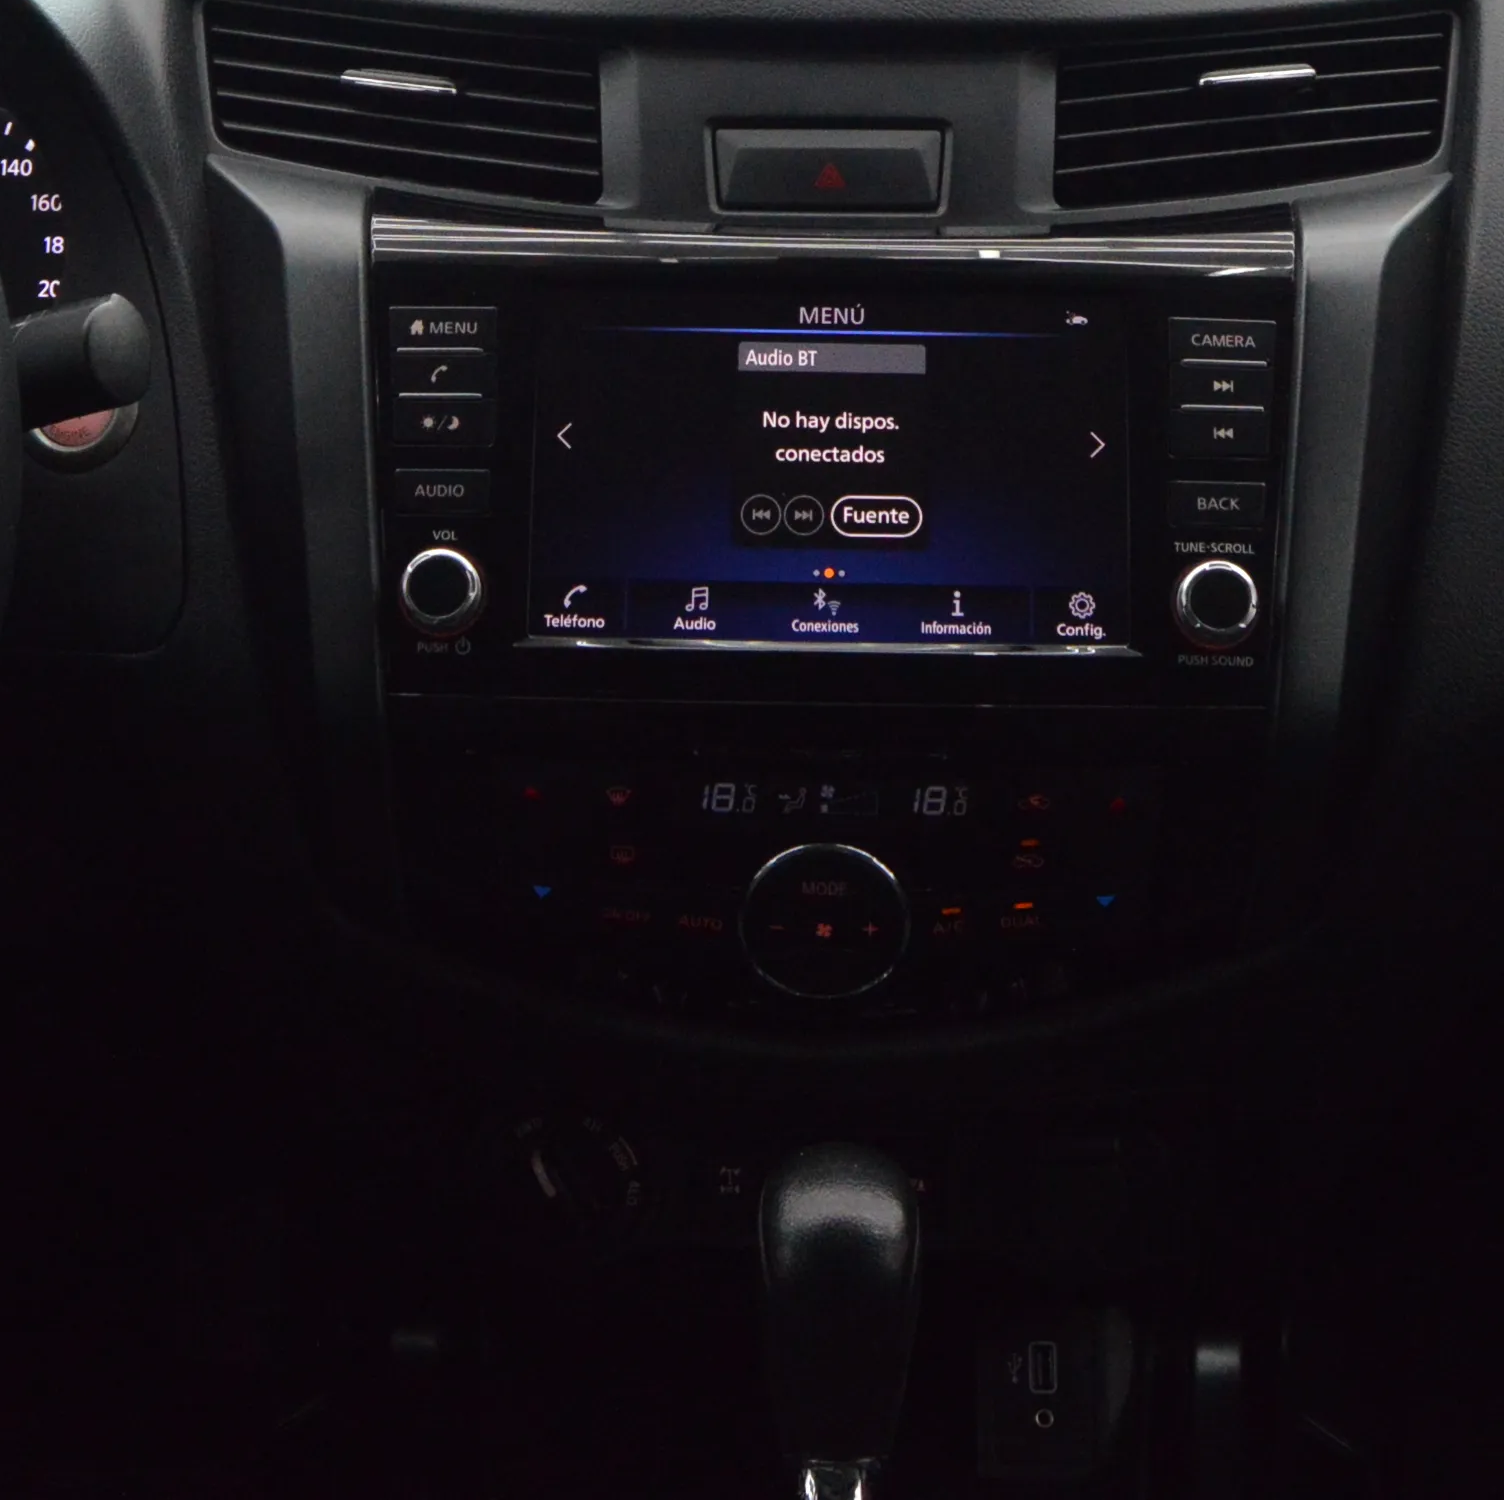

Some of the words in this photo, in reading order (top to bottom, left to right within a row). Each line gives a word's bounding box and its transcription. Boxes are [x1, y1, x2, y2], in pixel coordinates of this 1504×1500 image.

[0, 158, 33, 177] 140
[43, 235, 65, 254] 18
[799, 303, 866, 326] MENÚ
[429, 320, 479, 336] MENU
[1191, 334, 1257, 349] CAMERA
[746, 349, 794, 367] Audio
[798, 350, 819, 367] BT
[762, 410, 791, 429] No
[796, 410, 831, 434] hay
[835, 412, 900, 435] dispos.
[775, 444, 886, 464] conectados
[414, 484, 466, 498] AUDIO
[1197, 496, 1241, 511] BACK
[843, 506, 911, 525] Fuente
[432, 529, 459, 542] VOL
[544, 613, 606, 629] Teléfono
[673, 616, 717, 631] Audio
[791, 618, 860, 633] Conexiones
[920, 620, 993, 636] Información
[1056, 622, 1107, 640] Config.
[1177, 654, 1208, 667] PUSH
[1211, 655, 1255, 668] SOUND
[678, 913, 724, 932] AUTO
